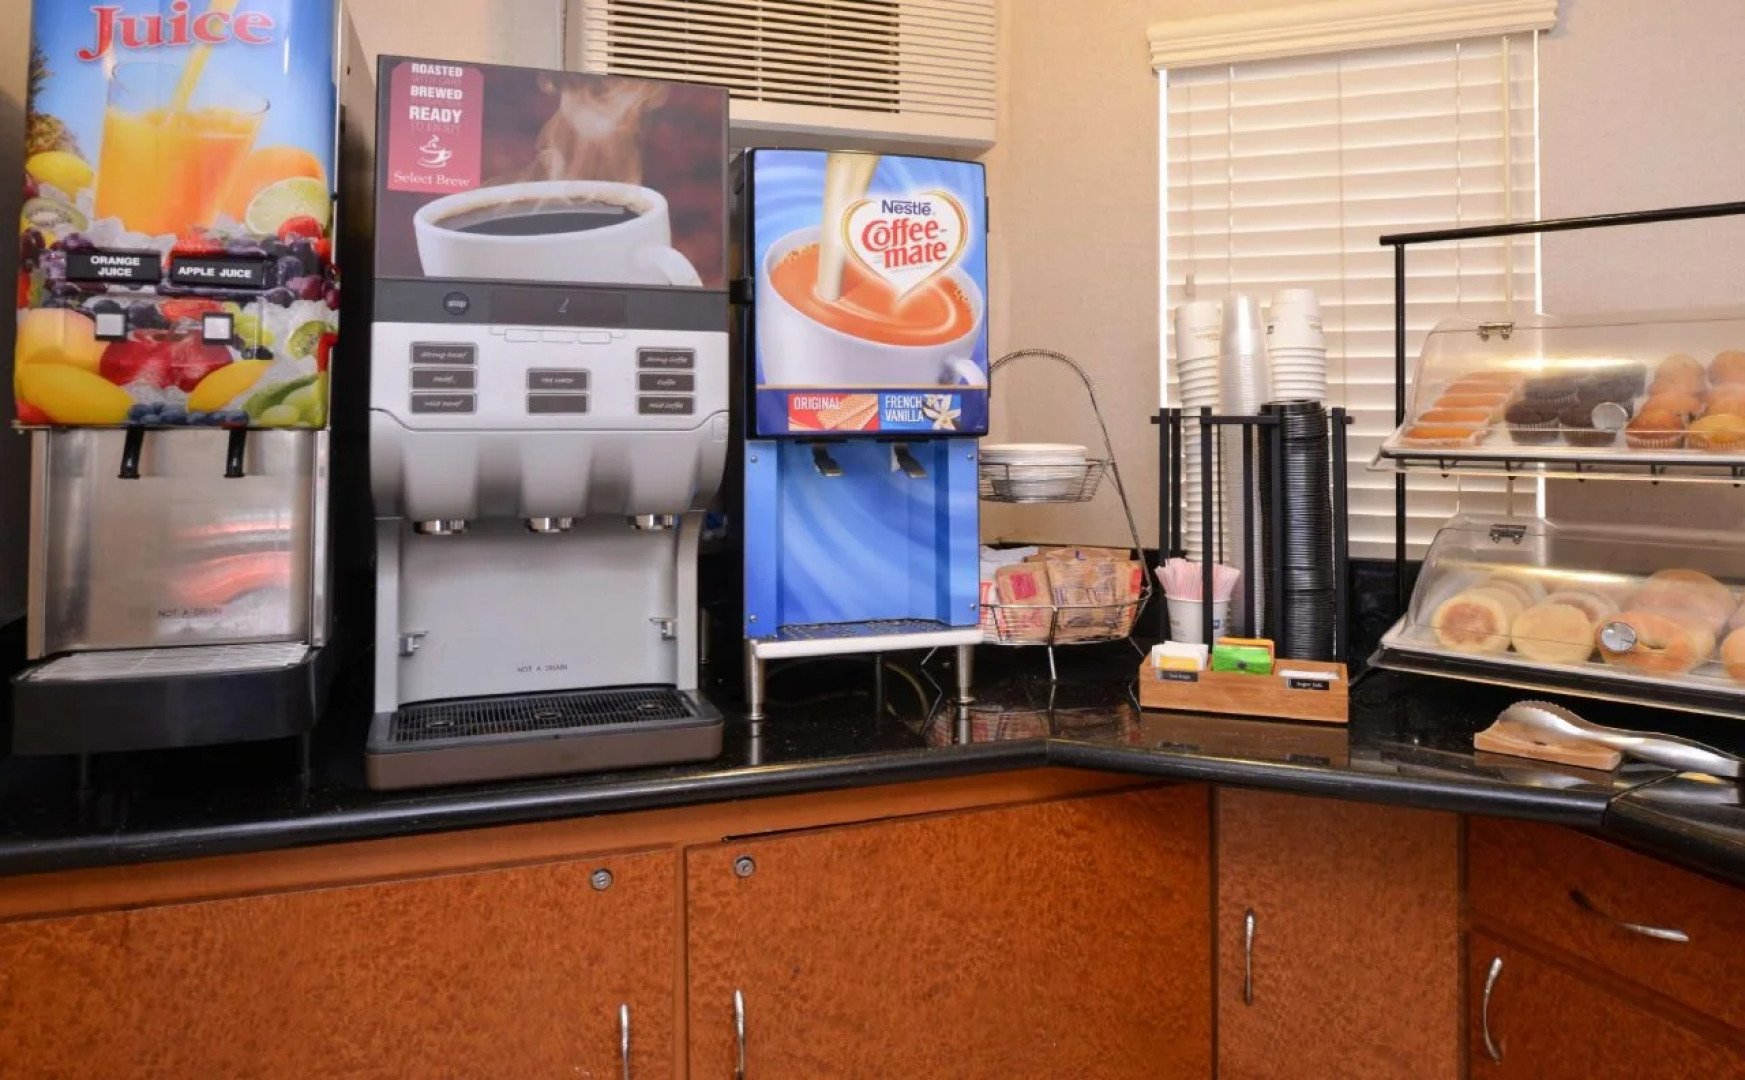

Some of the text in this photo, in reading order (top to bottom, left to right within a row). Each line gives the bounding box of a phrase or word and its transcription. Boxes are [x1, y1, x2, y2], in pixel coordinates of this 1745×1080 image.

[77, 1, 275, 61] Juice
[411, 63, 463, 77] ROASTED
[410, 85, 463, 100] BREWED
[409, 105, 462, 123] READY
[394, 171, 470, 186] Select Brew
[90, 255, 140, 266] ORANGE
[884, 241, 947, 268] mate
[98, 268, 132, 277] JUICE
[177, 266, 252, 278] APPLE JUICE
[794, 397, 841, 410] ORIGINAL
[885, 395, 923, 409] FRENCH
[885, 409, 924, 423] VANILLA
